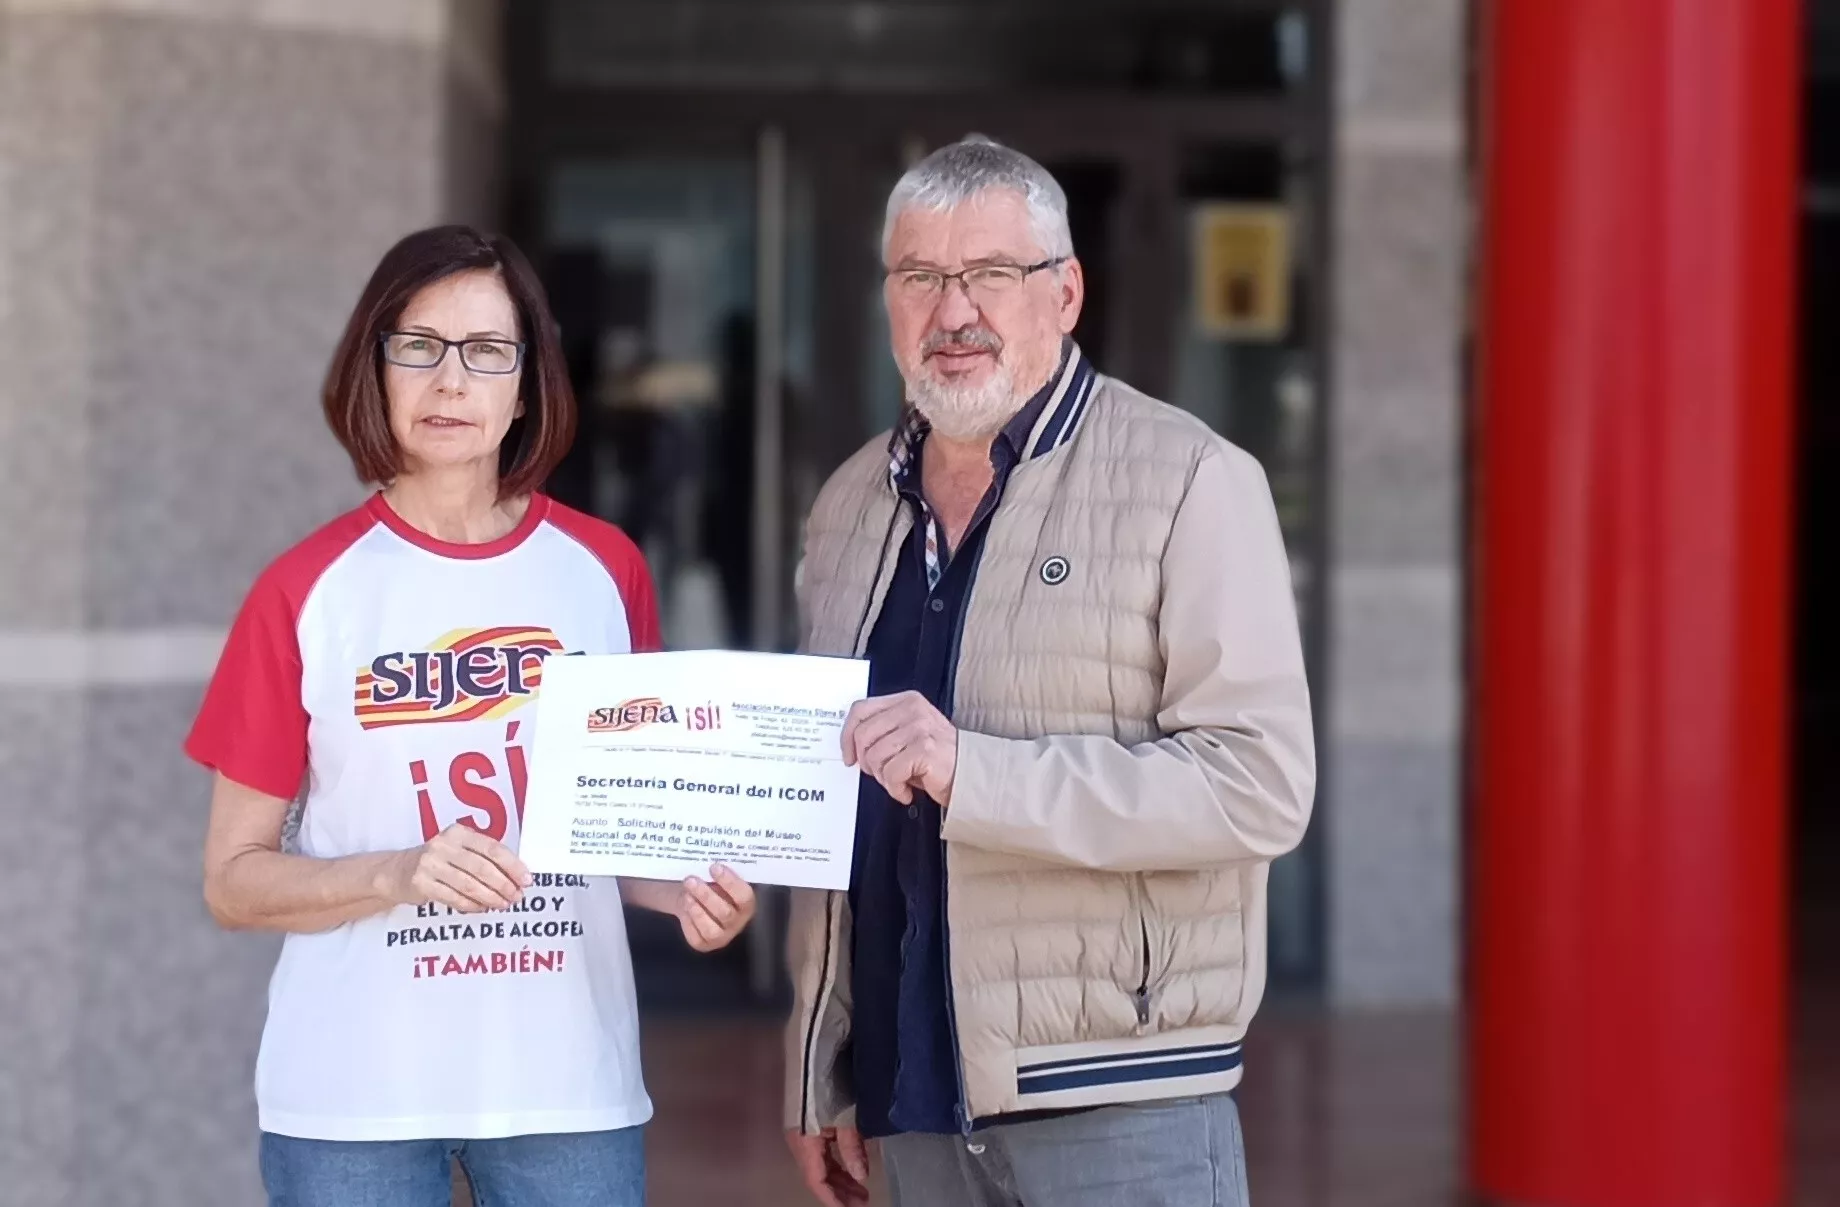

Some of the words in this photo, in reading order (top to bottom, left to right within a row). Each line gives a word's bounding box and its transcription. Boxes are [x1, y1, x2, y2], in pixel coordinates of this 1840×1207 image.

[685, 700, 721, 731] ¡SÍ!
[673, 778, 740, 795] General
[746, 785, 773, 798] del
[779, 787, 825, 802] ICOM
[571, 829, 620, 840] Nacional
[623, 832, 637, 841] de
[641, 832, 663, 843] Arte
[668, 836, 681, 844] de
[685, 836, 733, 849] Cataluña
[617, 818, 666, 829] Solicitud
[669, 822, 683, 831] de
[687, 825, 740, 836] expulsión
[745, 828, 761, 838] del
[765, 830, 802, 841] Museo
[417, 901, 439, 917] EL
[551, 896, 565, 912] Y
[386, 923, 476, 948] PERALTA
[480, 921, 505, 939] DE
[413, 944, 565, 979] ¡TAMBIÉN!
